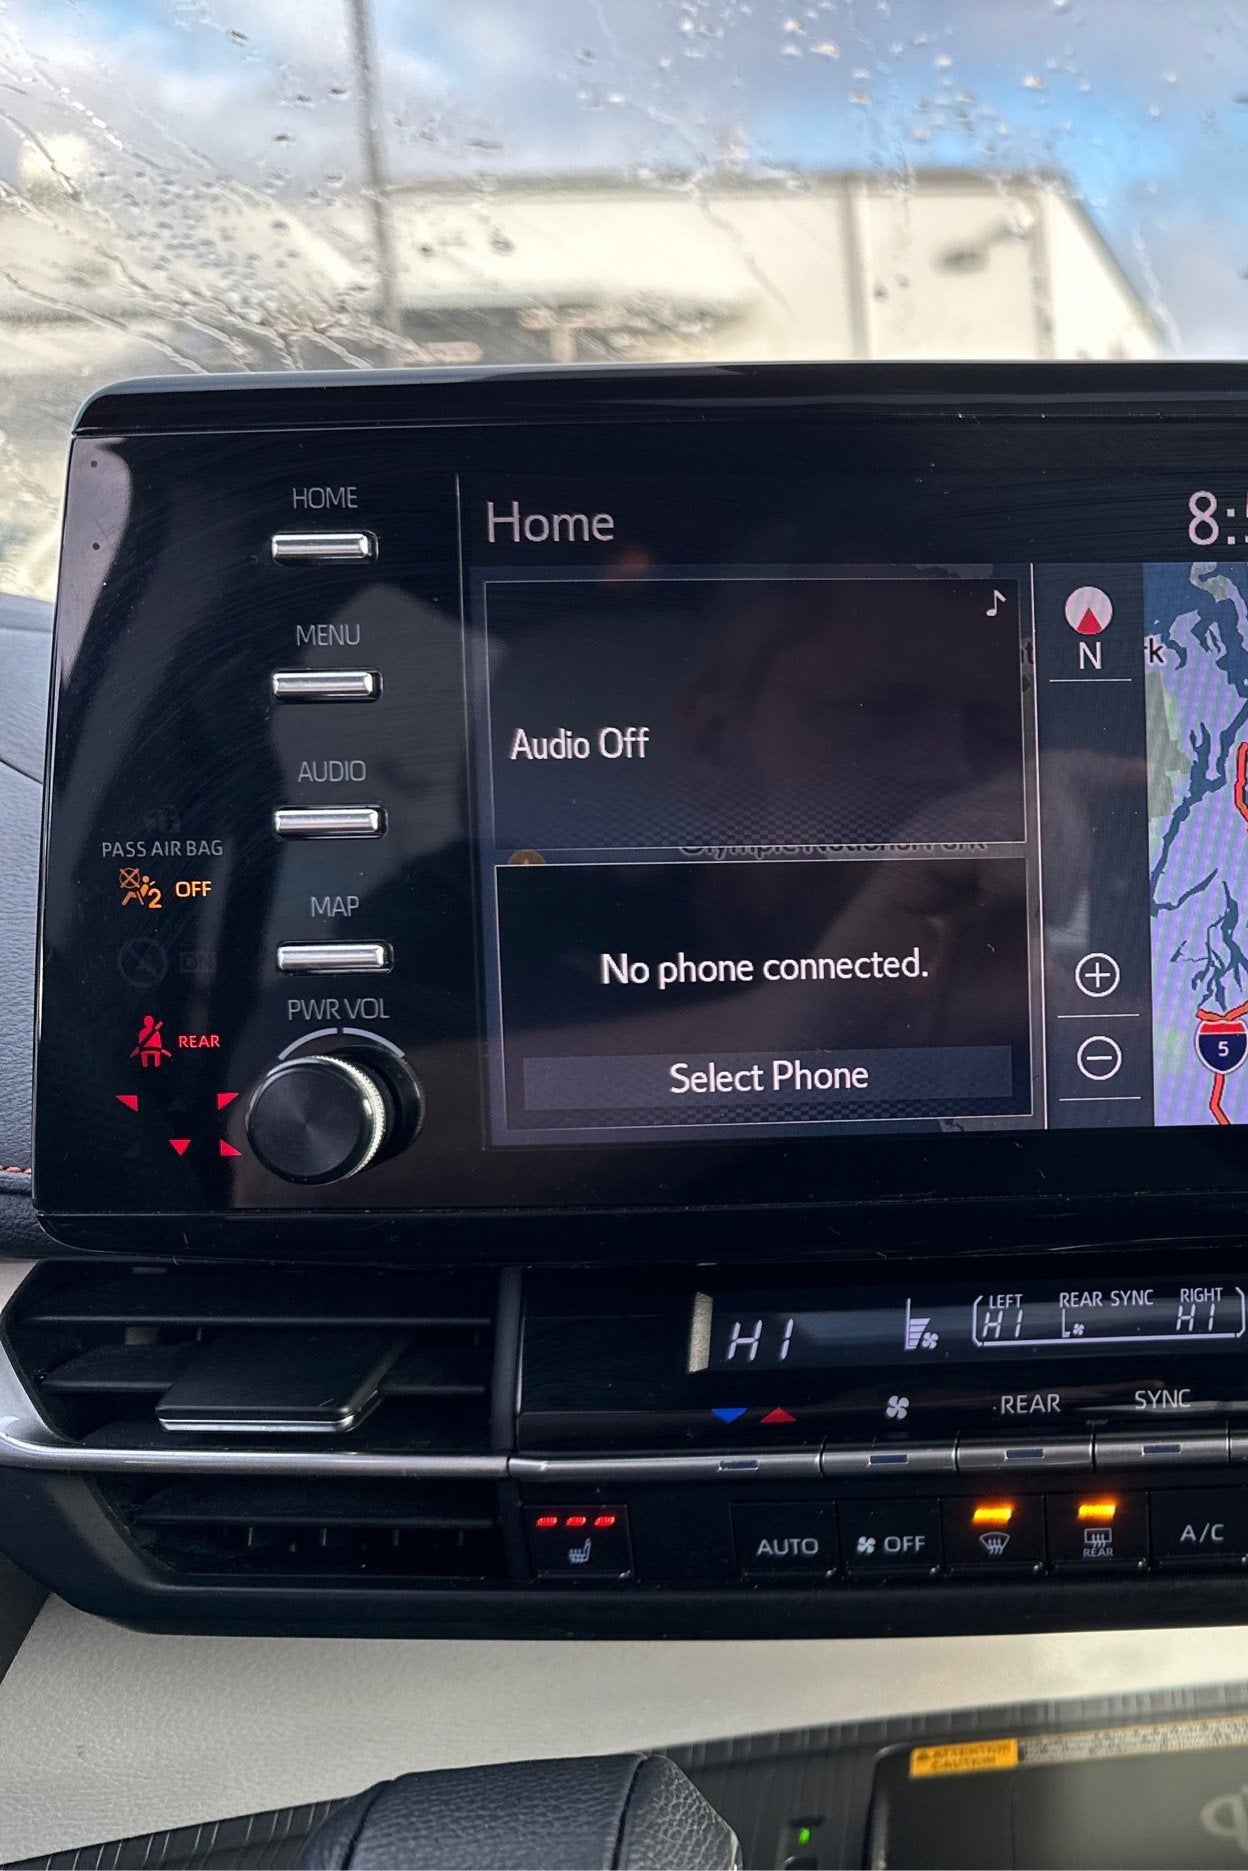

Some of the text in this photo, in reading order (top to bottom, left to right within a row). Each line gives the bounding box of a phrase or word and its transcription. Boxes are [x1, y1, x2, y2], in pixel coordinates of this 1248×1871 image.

[292, 487, 358, 509] HOME
[486, 501, 615, 543] Home
[296, 625, 360, 646] MENU
[1079, 641, 1102, 670] N
[510, 727, 649, 760] Audio Off
[298, 761, 367, 782] AUDIO
[102, 840, 223, 857] PASS AIR BAG
[175, 881, 212, 898] OFF
[310, 896, 360, 917] MAP
[601, 948, 929, 990] No phone connected.
[288, 998, 390, 1020] PWR VOL
[178, 1036, 220, 1048] REAR
[1217, 1041, 1229, 1057] 5
[669, 1061, 869, 1094] Select Phone
[989, 1294, 1023, 1308] LEFT
[1059, 1290, 1155, 1308] REAR SYNC
[1180, 1287, 1223, 1302] RIGHT
[1001, 1394, 1062, 1414] REAR
[1134, 1389, 1192, 1408] SYNC
[1180, 1524, 1225, 1542] A/C
[757, 1538, 819, 1556] AUTO
[883, 1536, 926, 1554] OFF
[1083, 1547, 1114, 1558] REAR
